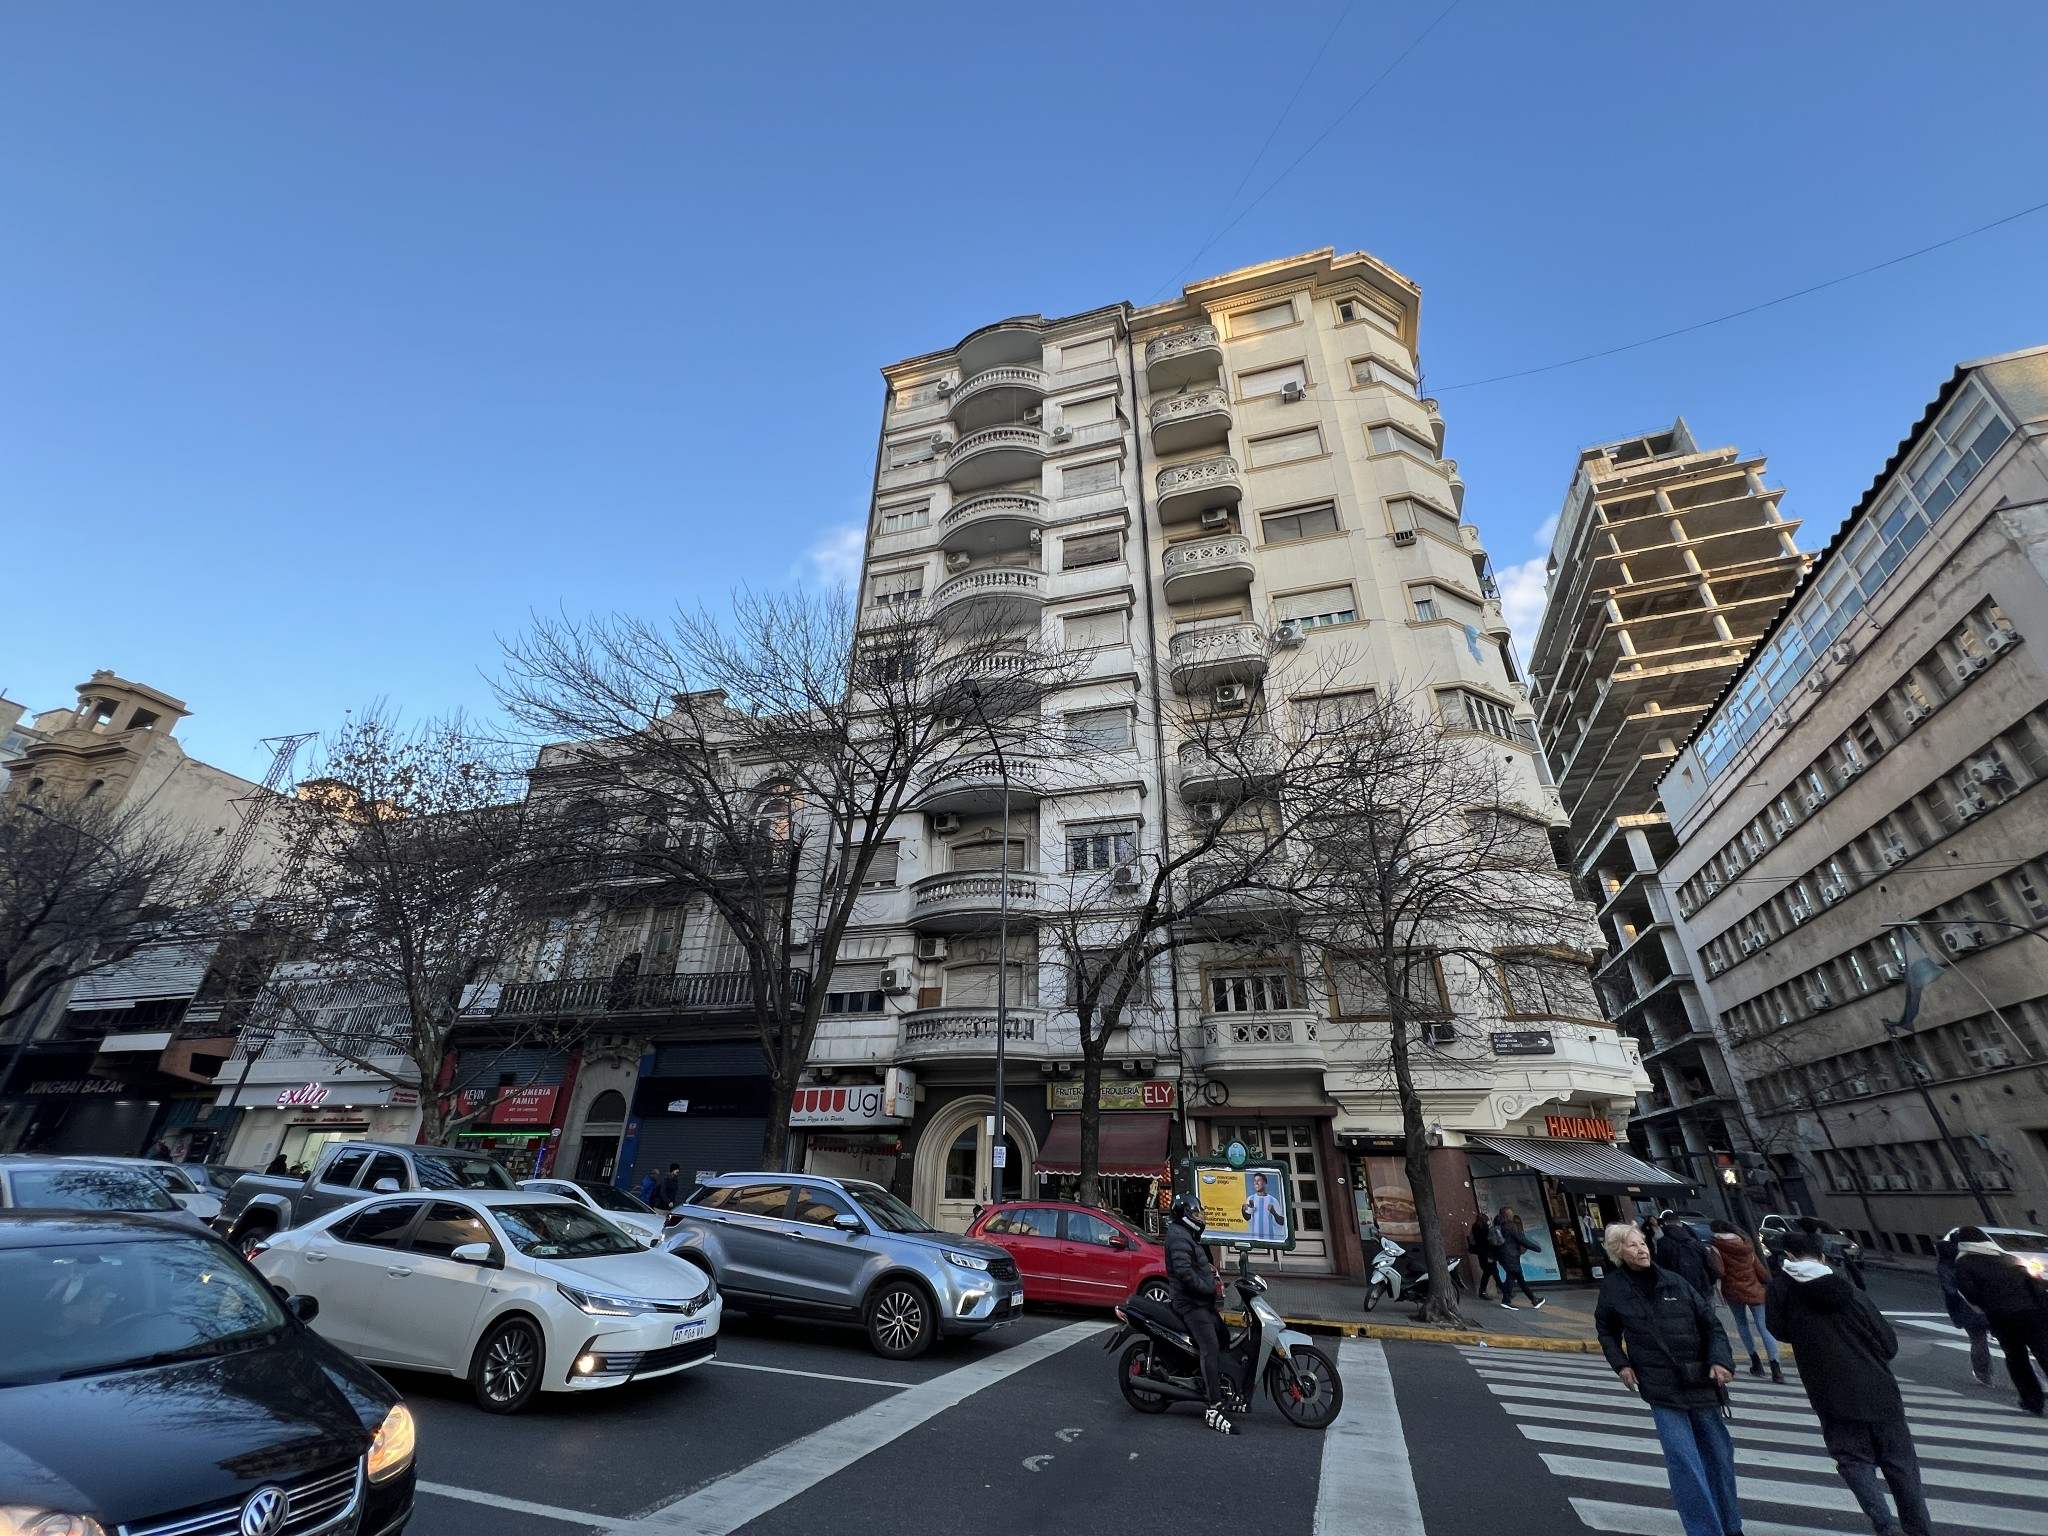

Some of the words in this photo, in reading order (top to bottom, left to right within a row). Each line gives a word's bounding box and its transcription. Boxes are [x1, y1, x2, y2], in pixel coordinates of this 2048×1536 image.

[463, 1089, 486, 1100] KEVIN
[511, 1097, 540, 1105] FAMILY
[1143, 1086, 1172, 1104] ELY
[1547, 1115, 1617, 1140] HAVANNA
